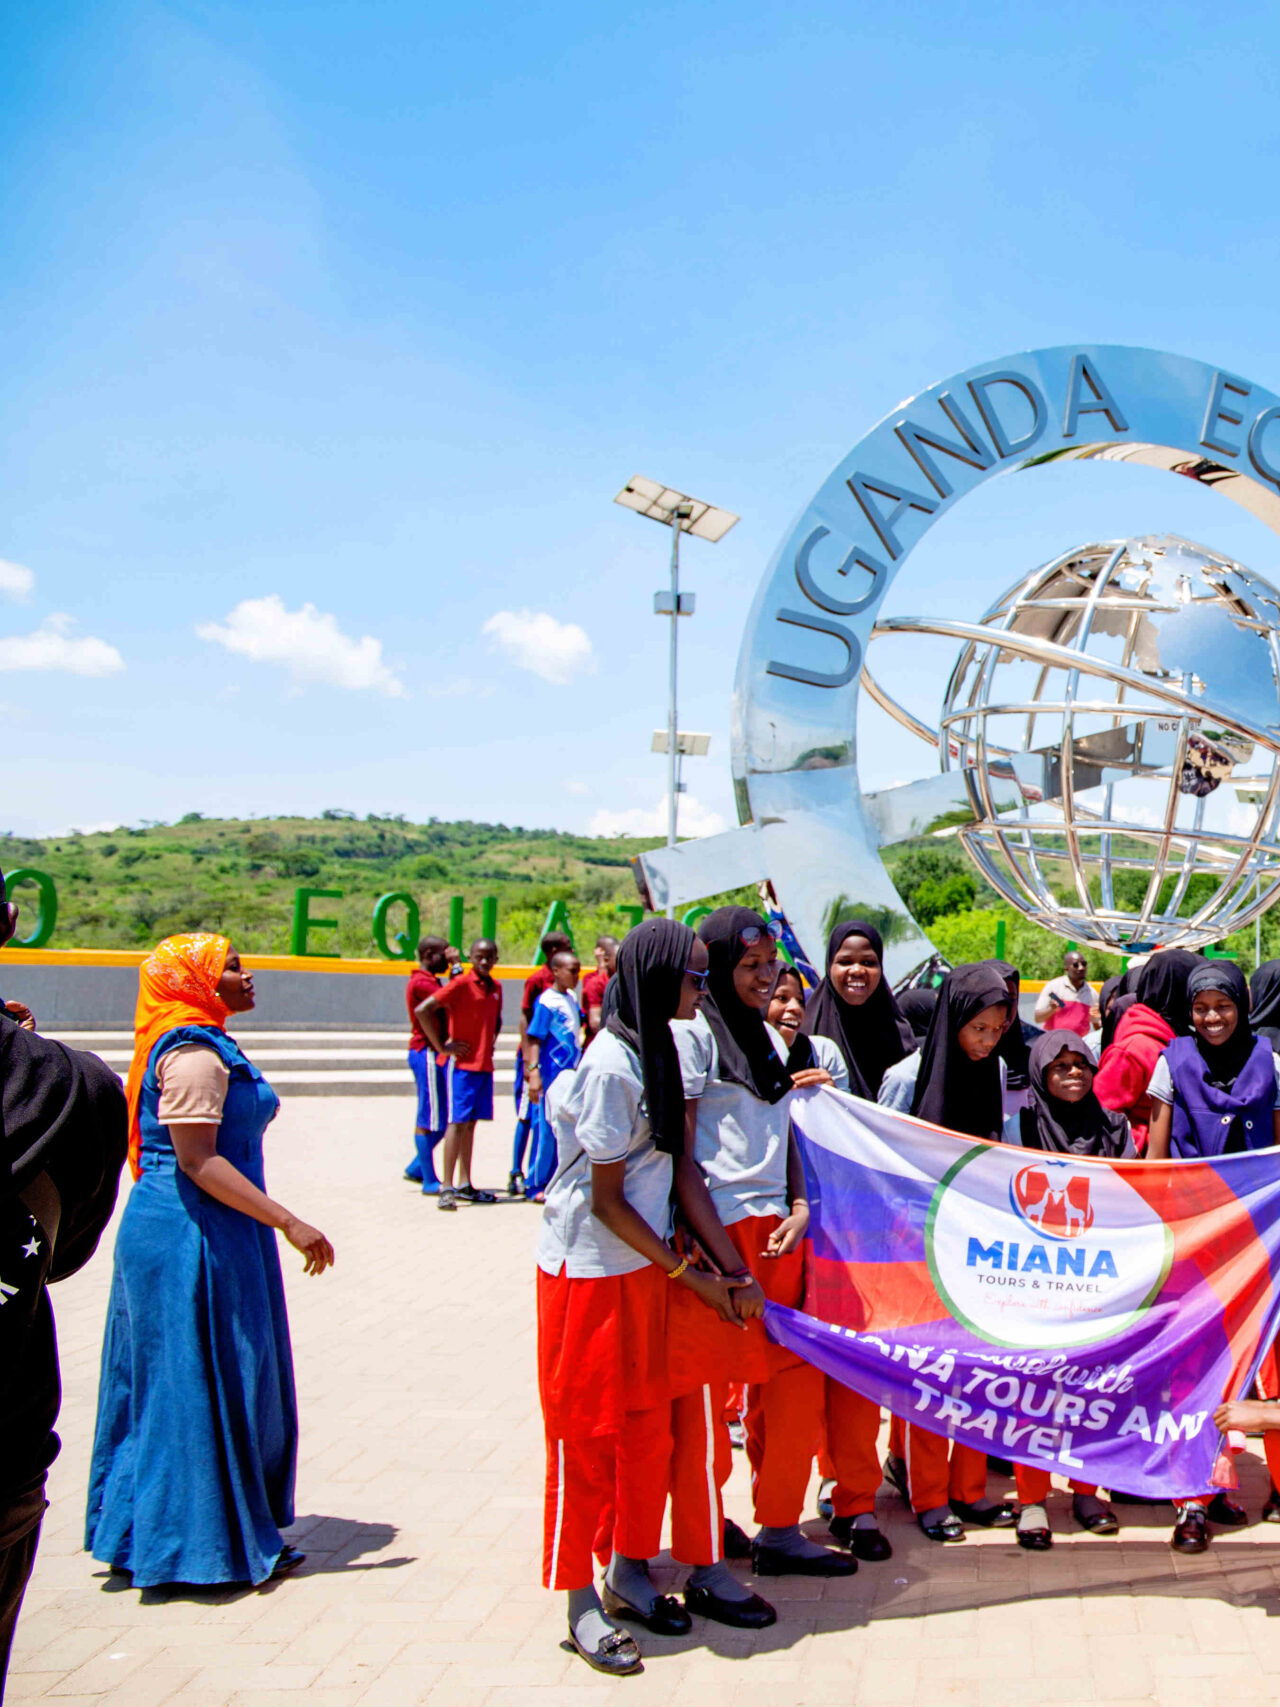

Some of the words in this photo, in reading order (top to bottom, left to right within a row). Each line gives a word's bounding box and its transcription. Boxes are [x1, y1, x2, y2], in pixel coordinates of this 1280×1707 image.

[766, 354, 1129, 688] UGANDA
[966, 1237, 1119, 1278] MIANA
[977, 1274, 1026, 1289] TOURS
[1031, 1280, 1041, 1290] &
[1047, 1281, 1103, 1294] TRAVEL
[812, 1317, 956, 1384] ANA
[962, 1367, 1116, 1431] TOURS
[1052, 1364, 1135, 1394] with
[911, 1378, 1084, 1470] TRAVEL
